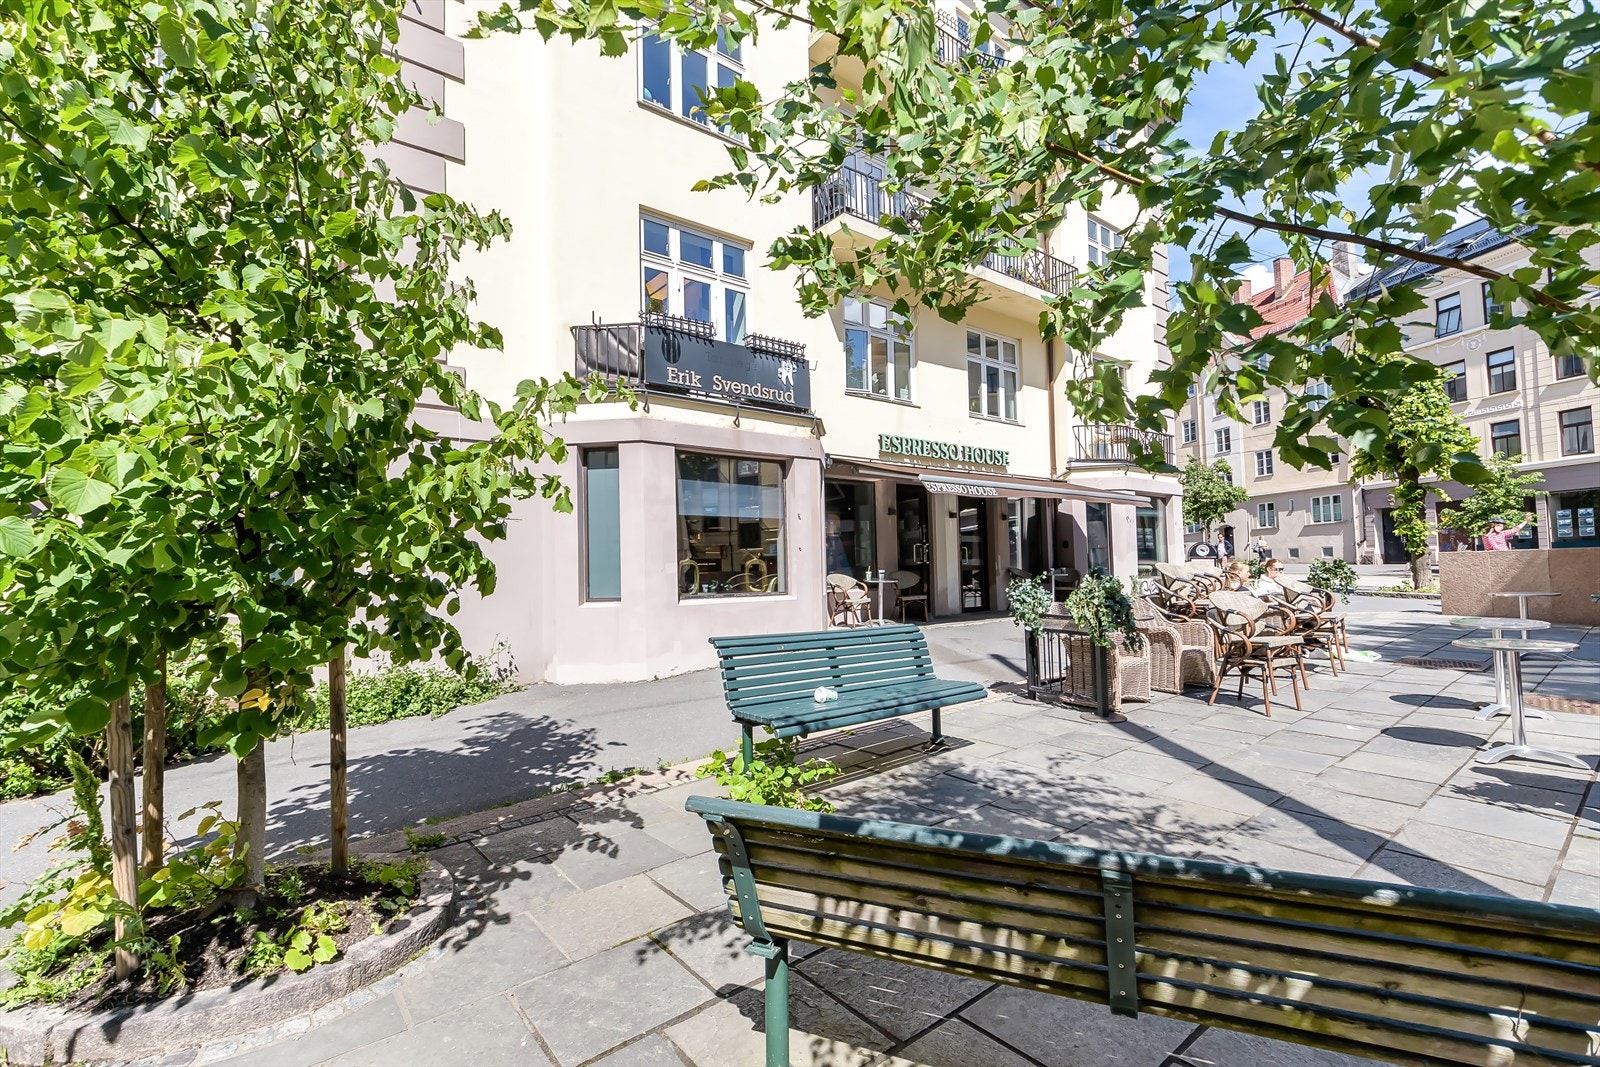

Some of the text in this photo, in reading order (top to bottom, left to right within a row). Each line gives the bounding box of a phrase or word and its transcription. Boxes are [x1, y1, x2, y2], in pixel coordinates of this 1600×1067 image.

[667, 366, 796, 404] Erik Svendsrud
[878, 434, 1010, 466] ESPRESSO HOUSE
[924, 481, 999, 496] ESPRESSO HOUSE
